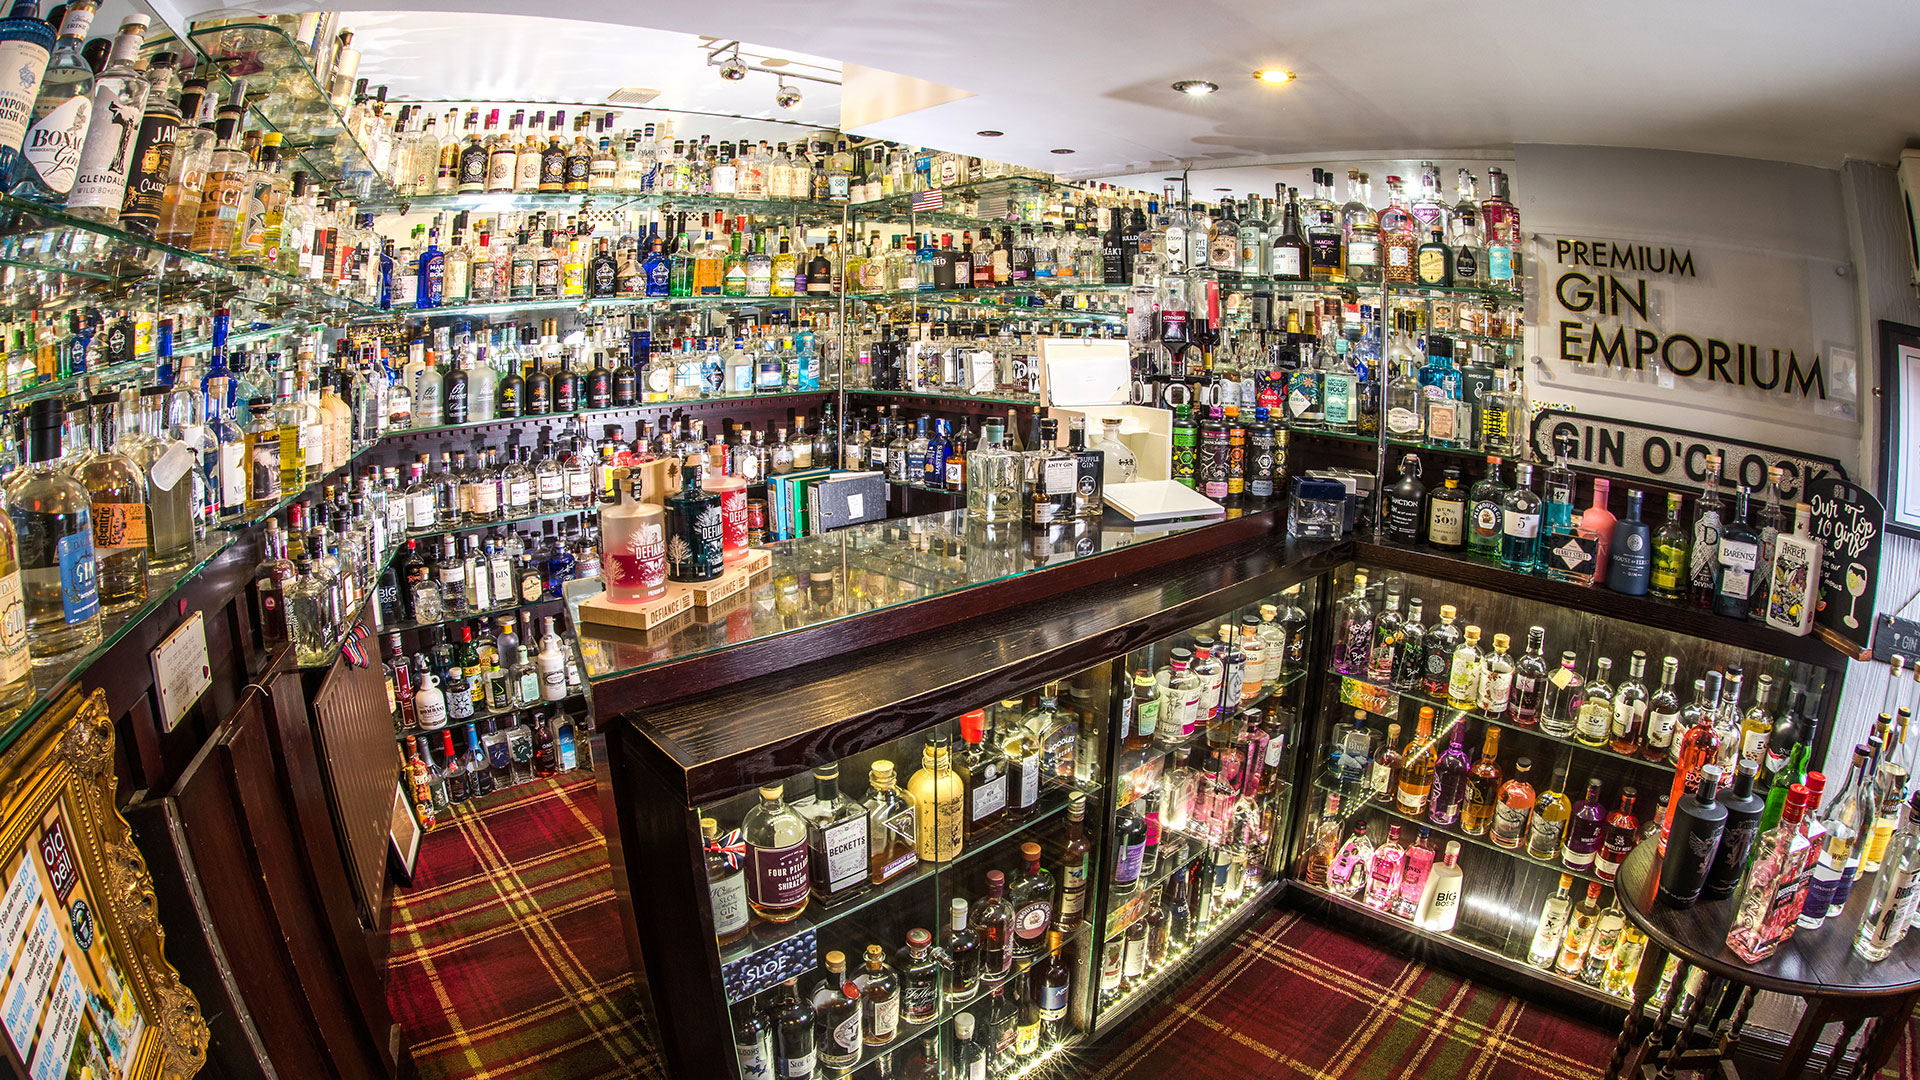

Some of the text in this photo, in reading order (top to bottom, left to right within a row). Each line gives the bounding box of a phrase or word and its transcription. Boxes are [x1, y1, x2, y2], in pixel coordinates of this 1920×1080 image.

[1556, 239, 1696, 277] PREMIUM
[1556, 272, 1648, 322] GIN
[1559, 320, 1827, 400] EMPORIUM
[1552, 422, 1625, 468] GIN
[1434, 515, 1457, 526] 509
[1473, 501, 1497, 519] PLYMOUTH
[1811, 495, 1876, 544] Our Top
[1817, 517, 1832, 537] 10
[1613, 553, 1631, 564] HOUSE
[1723, 547, 1755, 561] BARENTSZ
[1782, 542, 1807, 560] ARBER
[496, 570, 509, 579] GIN
[710, 580, 737, 602] DEFIANCE
[650, 600, 680, 624] DEFIANCE
[1902, 635, 1918, 652] GIN
[45, 823, 65, 866] old
[829, 836, 866, 858] BECKETTS
[50, 848, 73, 891] bell
[768, 868, 788, 877] FOUR
[11, 882, 22, 902] Tonics
[778, 880, 800, 891] SHIRAZ
[17, 899, 28, 920] Tonics
[719, 893, 737, 904] SLOE
[720, 904, 738, 916] GIN
[1015, 904, 1040, 929] PLYMOUTH
[24, 956, 37, 985] Premium
[747, 958, 787, 983] SLOE
[34, 979, 47, 1008] Premium
[6, 982, 24, 1032] PREMIUM
[22, 1006, 34, 1026] Tonic
[51, 1013, 63, 1042] Premium
[62, 1033, 72, 1062] Premium
